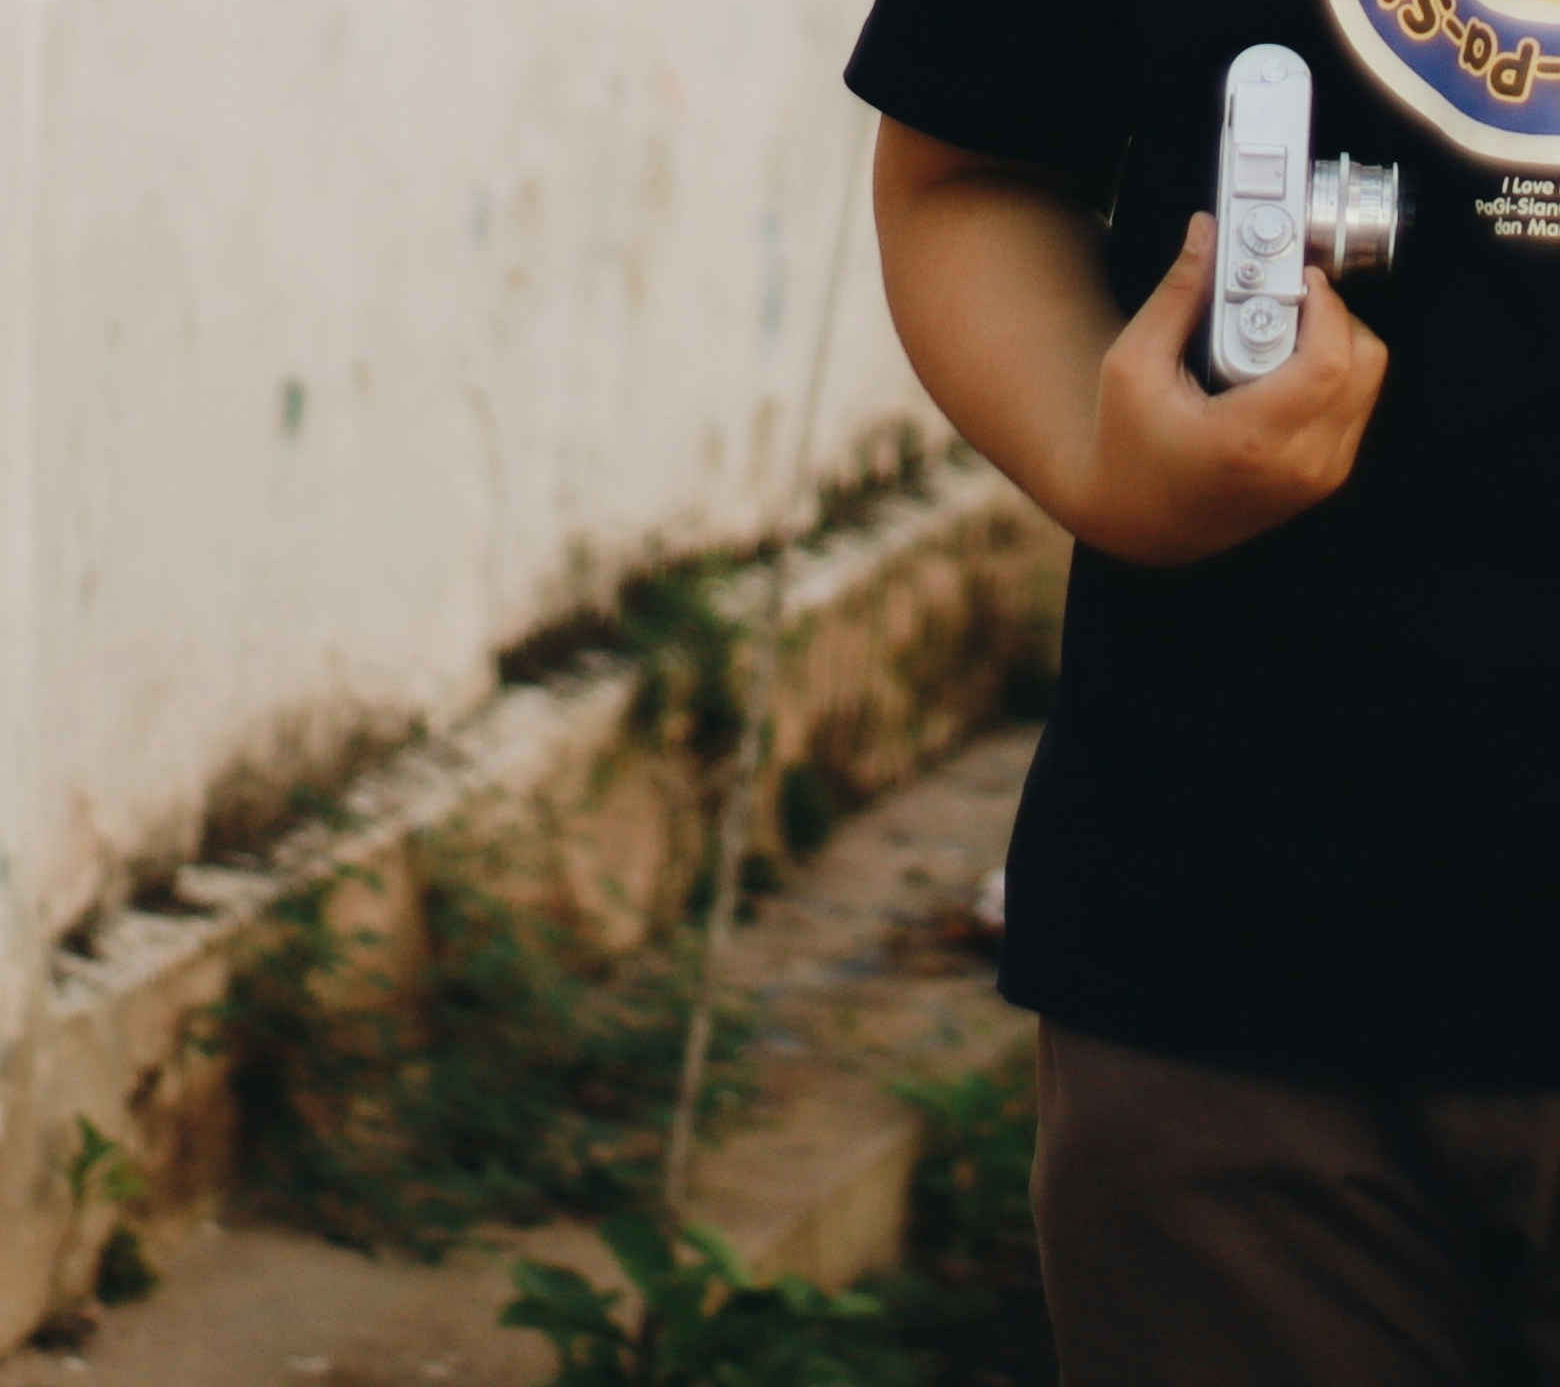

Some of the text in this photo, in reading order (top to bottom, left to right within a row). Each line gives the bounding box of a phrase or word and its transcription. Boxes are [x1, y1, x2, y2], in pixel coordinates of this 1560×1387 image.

[1501, 176, 1510, 194] I
[1512, 176, 1555, 196] Love
[1494, 217, 1523, 236] dan
